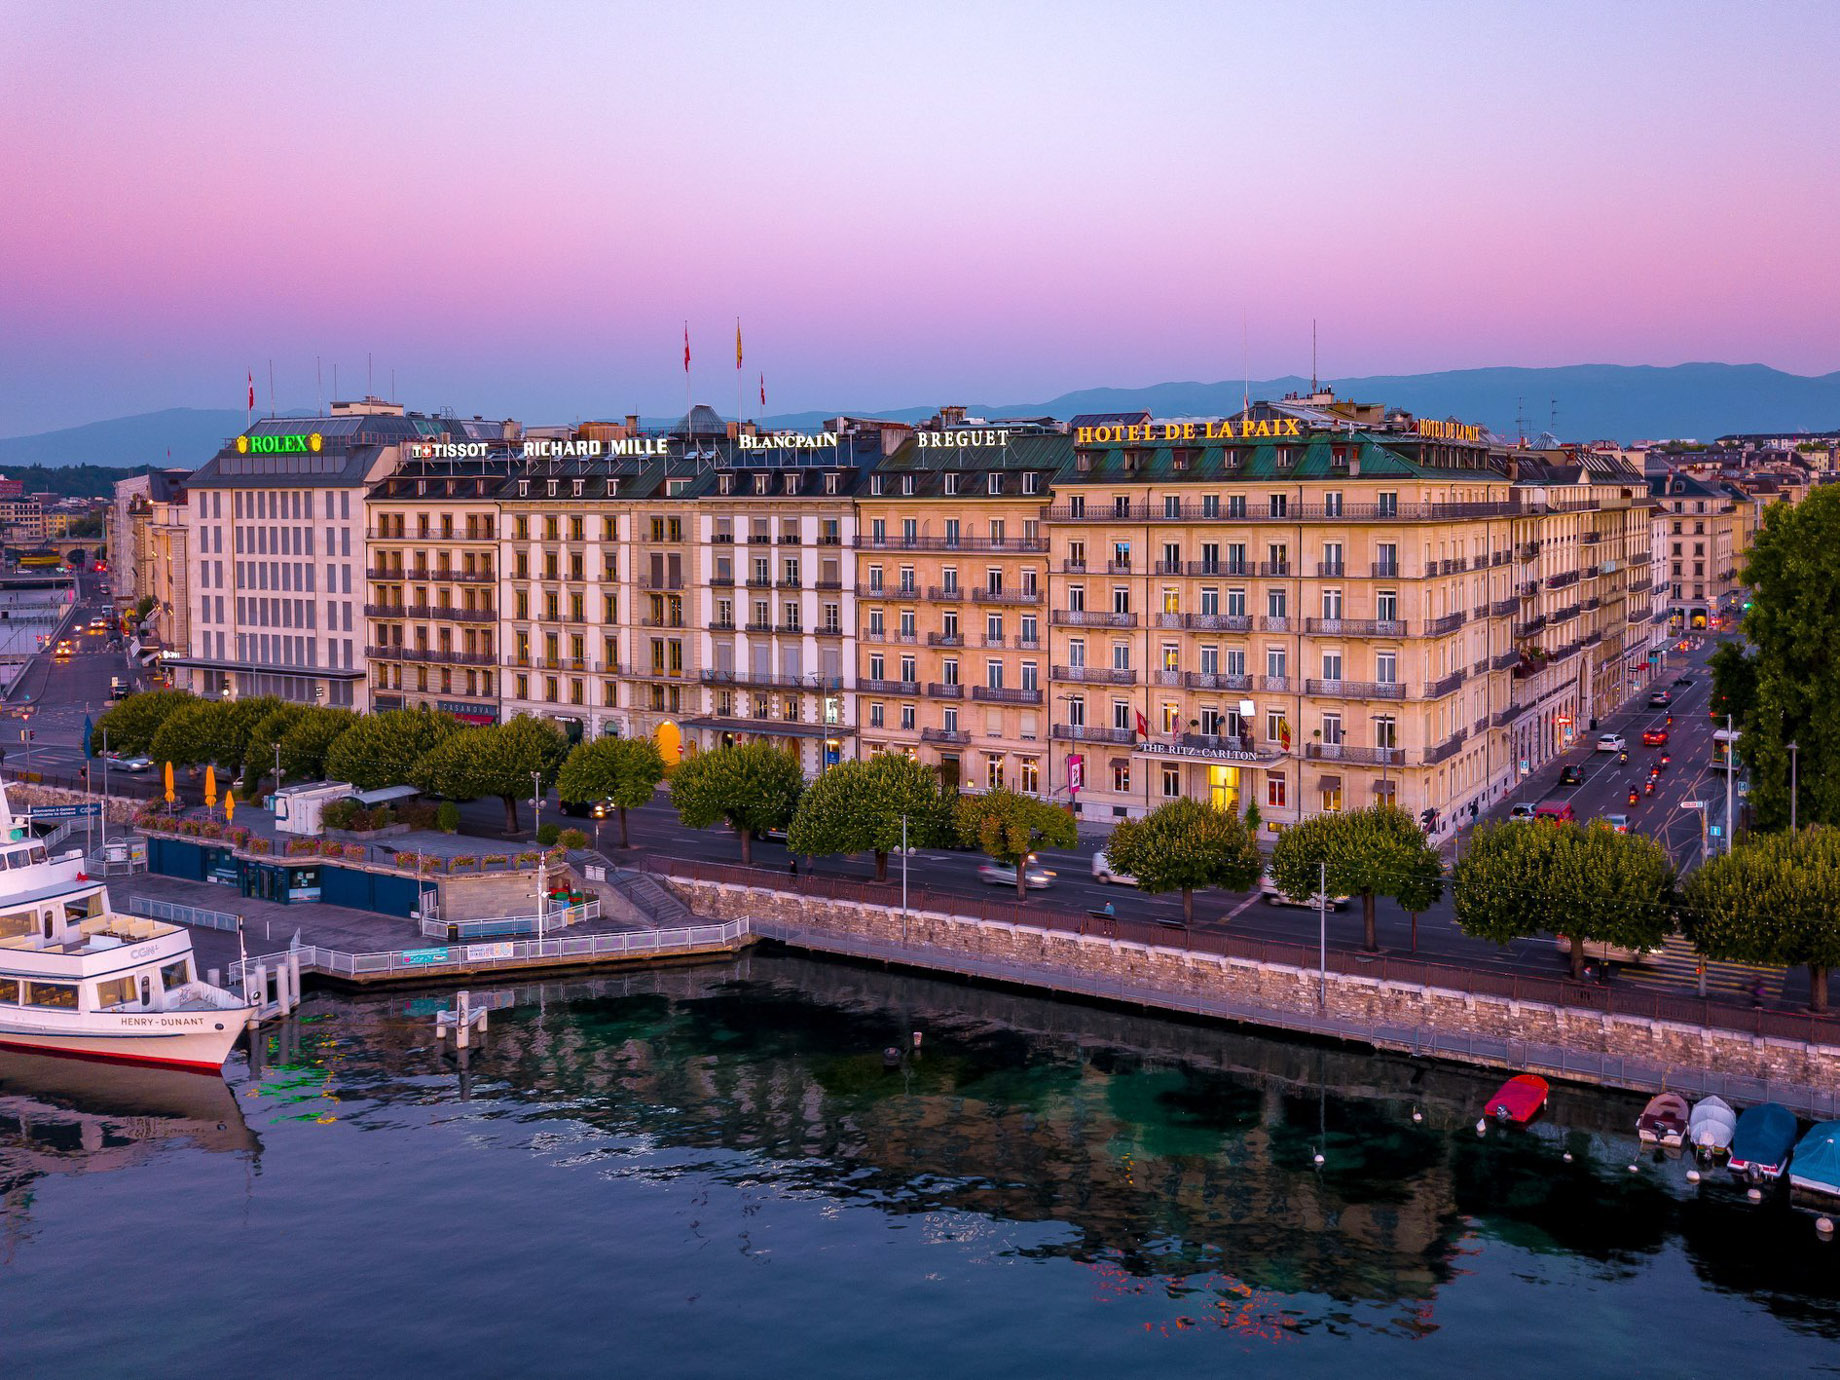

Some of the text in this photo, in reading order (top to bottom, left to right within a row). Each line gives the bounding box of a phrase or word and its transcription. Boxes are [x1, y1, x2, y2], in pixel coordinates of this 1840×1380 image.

[917, 429, 1009, 448] BREGUET
[1078, 418, 1300, 443] HOTEL DE LA PAIX
[1420, 419, 1479, 441] HOTEL DE LA PAIX
[250, 434, 308, 453] ROLEX
[431, 442, 489, 458] TISSOT
[523, 438, 668, 457] RICHARD MILLE
[738, 432, 838, 449] BLANCPAIN
[443, 703, 489, 714] CASANOVA
[1141, 743, 1166, 753] THE
